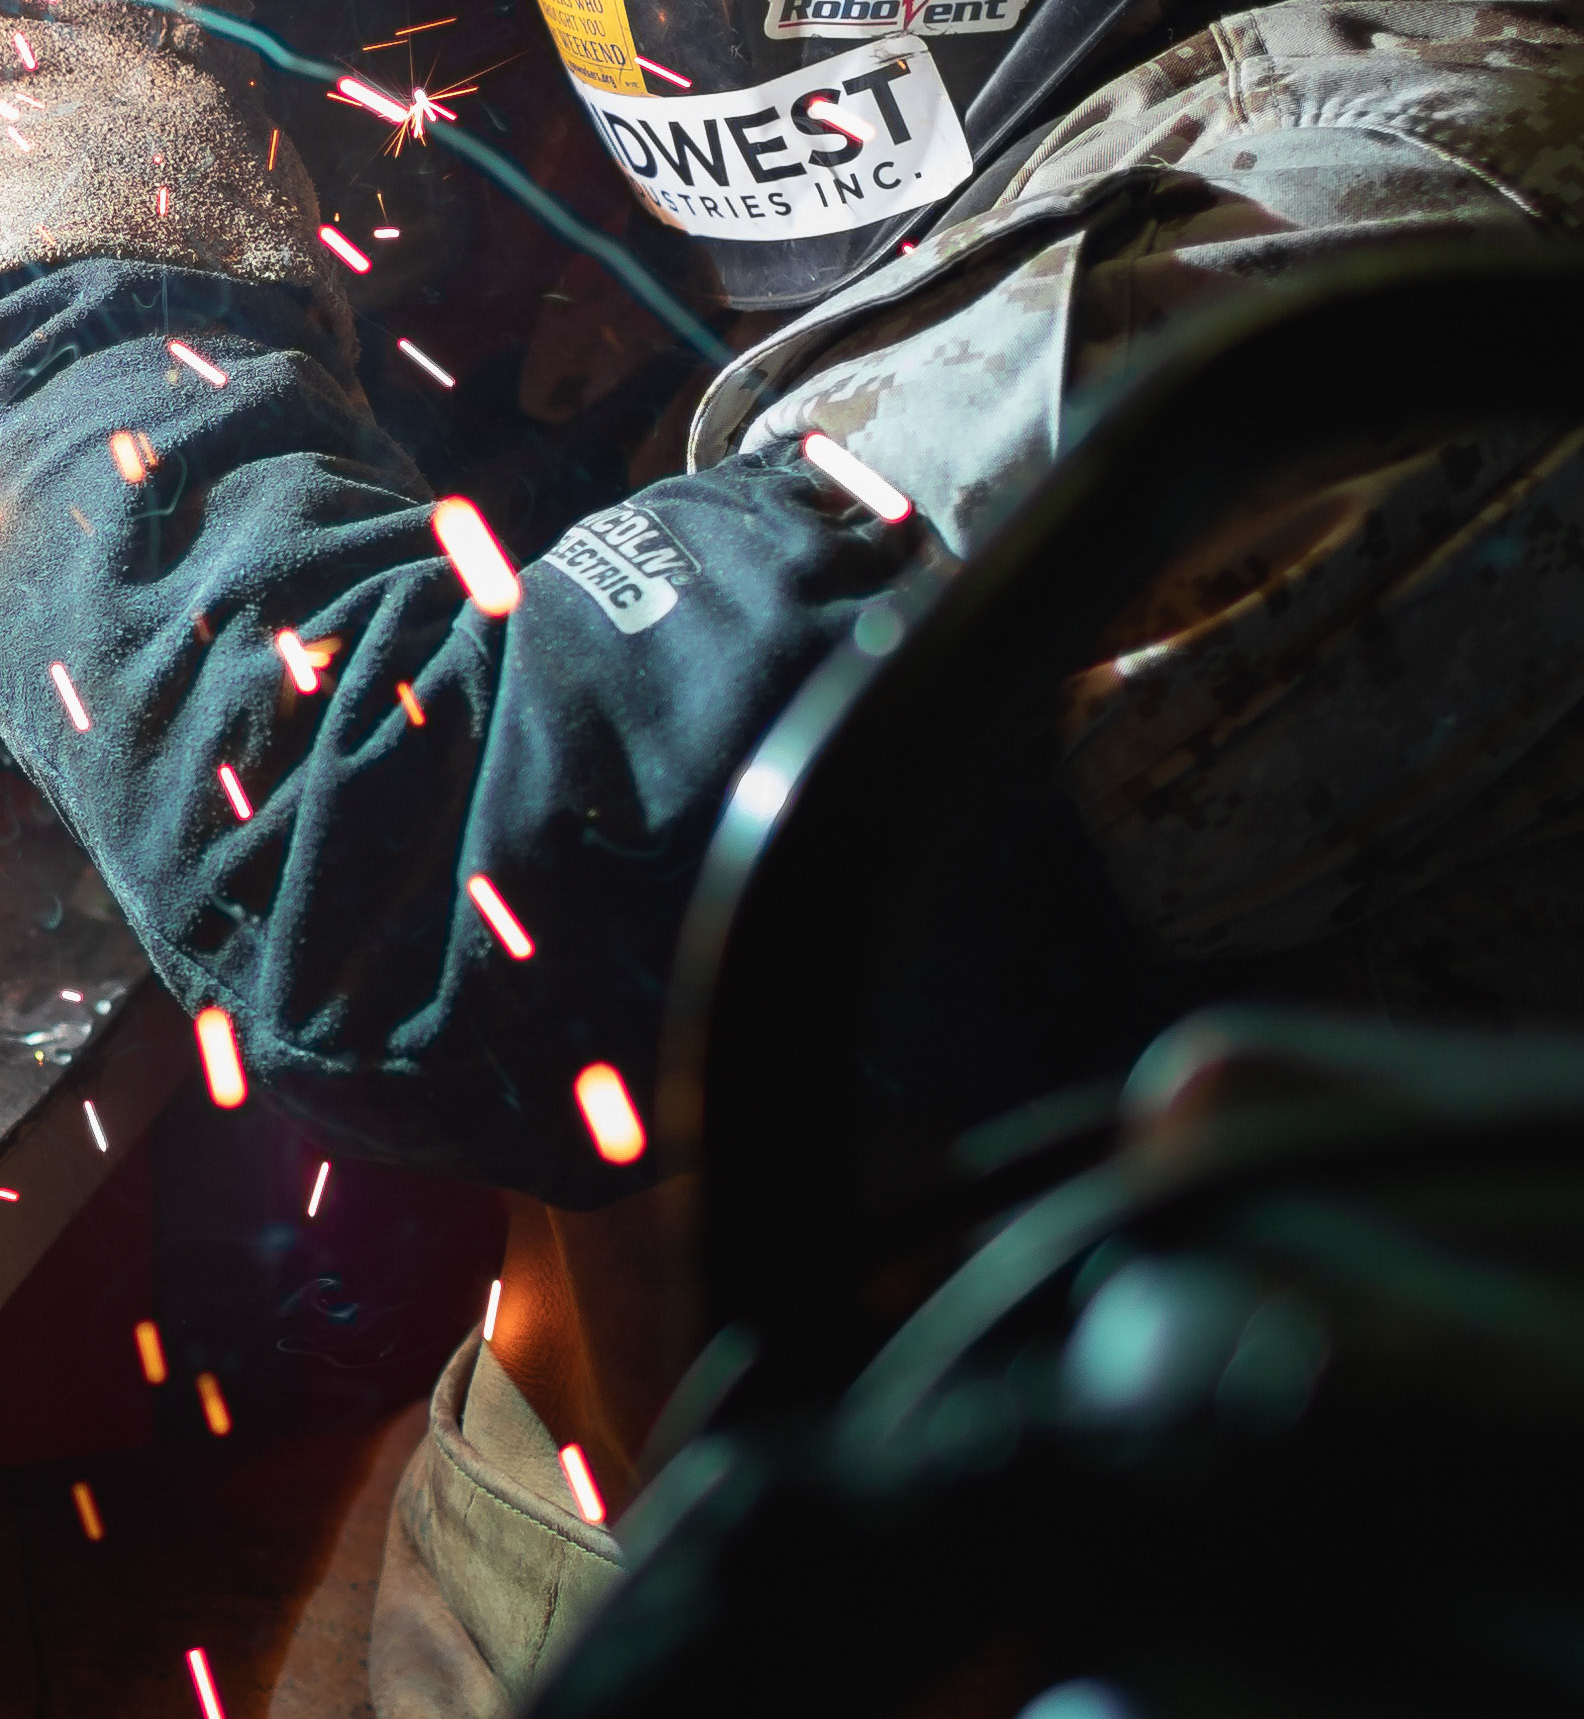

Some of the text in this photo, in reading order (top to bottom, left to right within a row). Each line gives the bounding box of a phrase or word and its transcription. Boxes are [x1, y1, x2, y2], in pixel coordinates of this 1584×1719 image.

[557, 28, 626, 66] WEEKEND
[579, 17, 606, 37] YOU
[589, 59, 912, 187] IDWEST
[632, 160, 923, 220] USTRIES INC.
